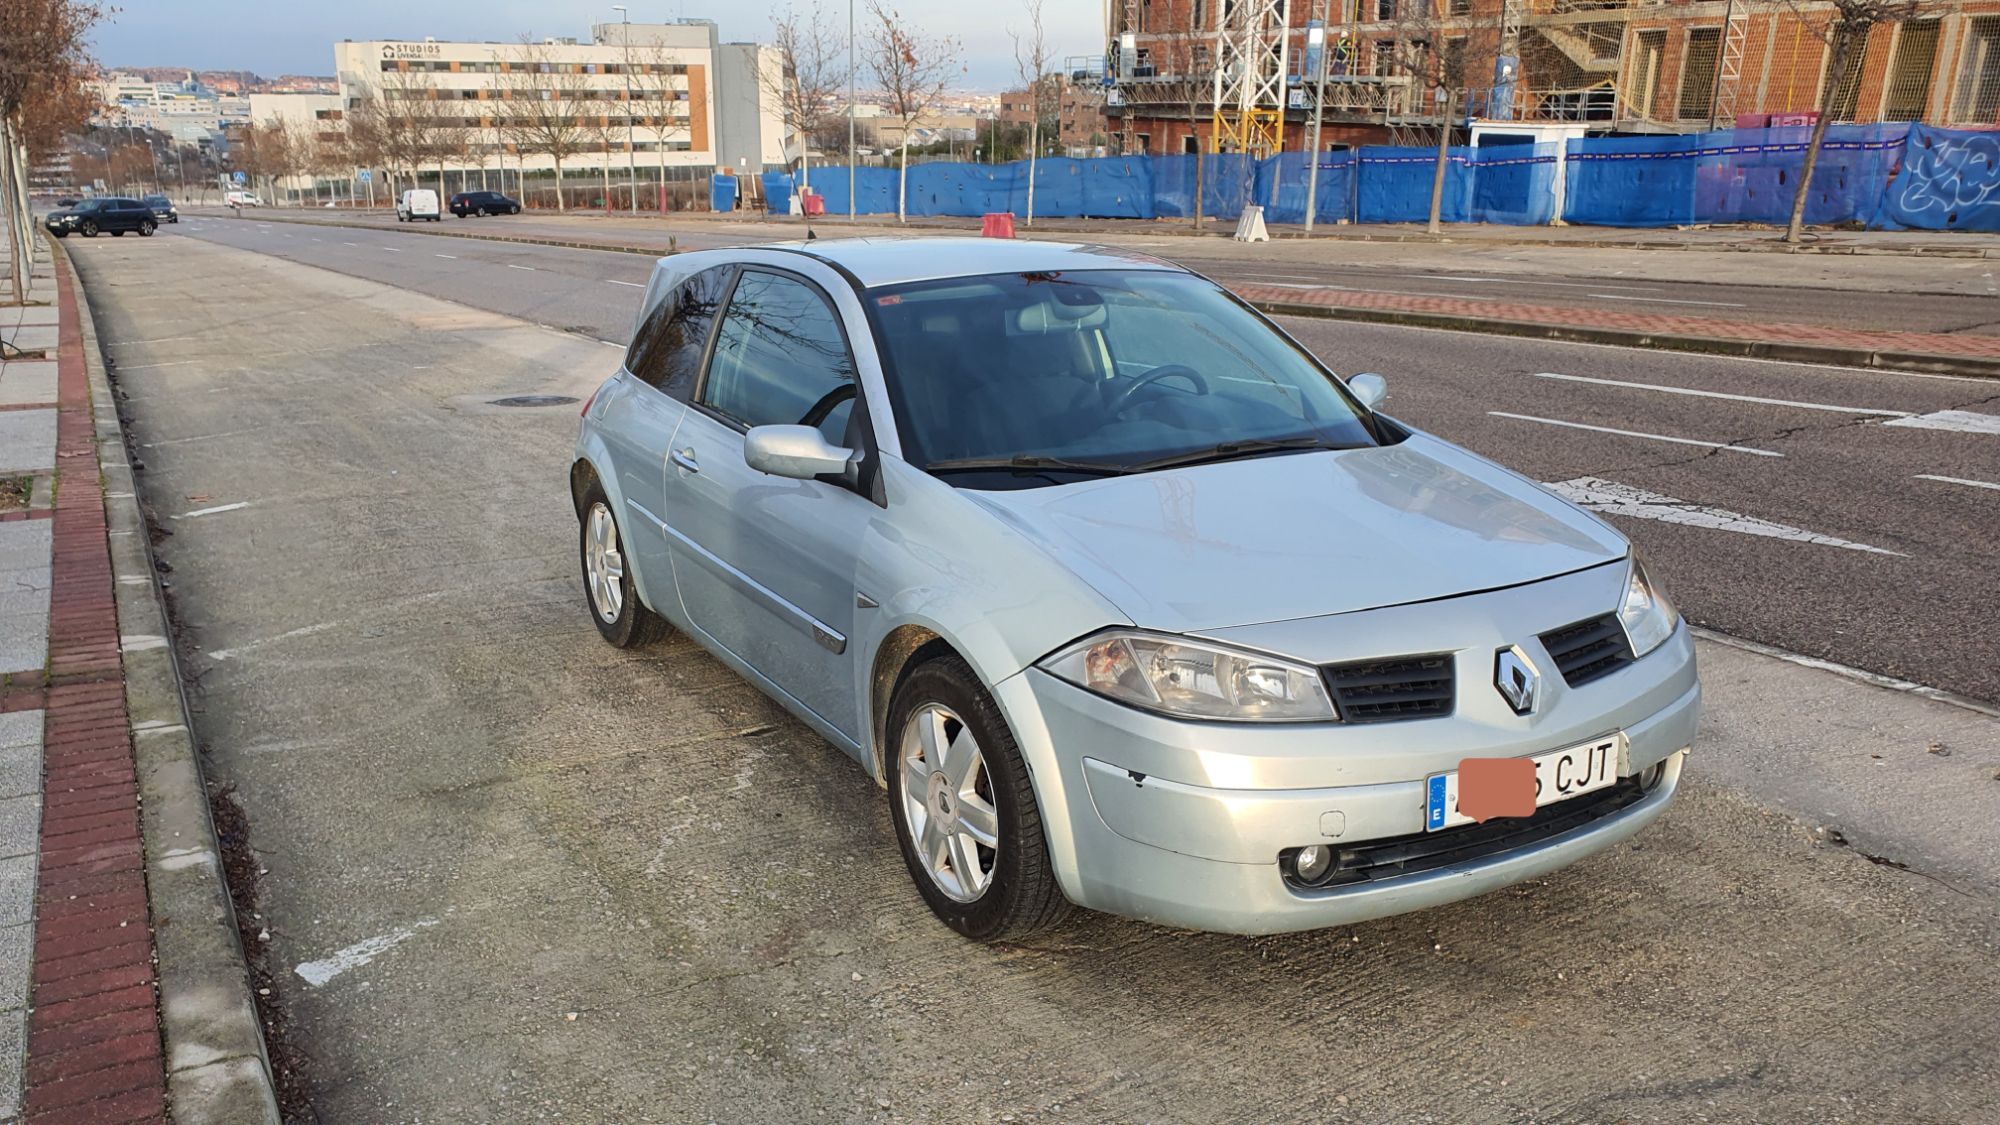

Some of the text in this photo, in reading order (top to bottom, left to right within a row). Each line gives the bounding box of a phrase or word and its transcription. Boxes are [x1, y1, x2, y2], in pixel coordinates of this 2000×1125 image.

[396, 44, 440, 53] STUDIOS
[1556, 743, 1612, 792] CJT
[1433, 808, 1441, 820] E
